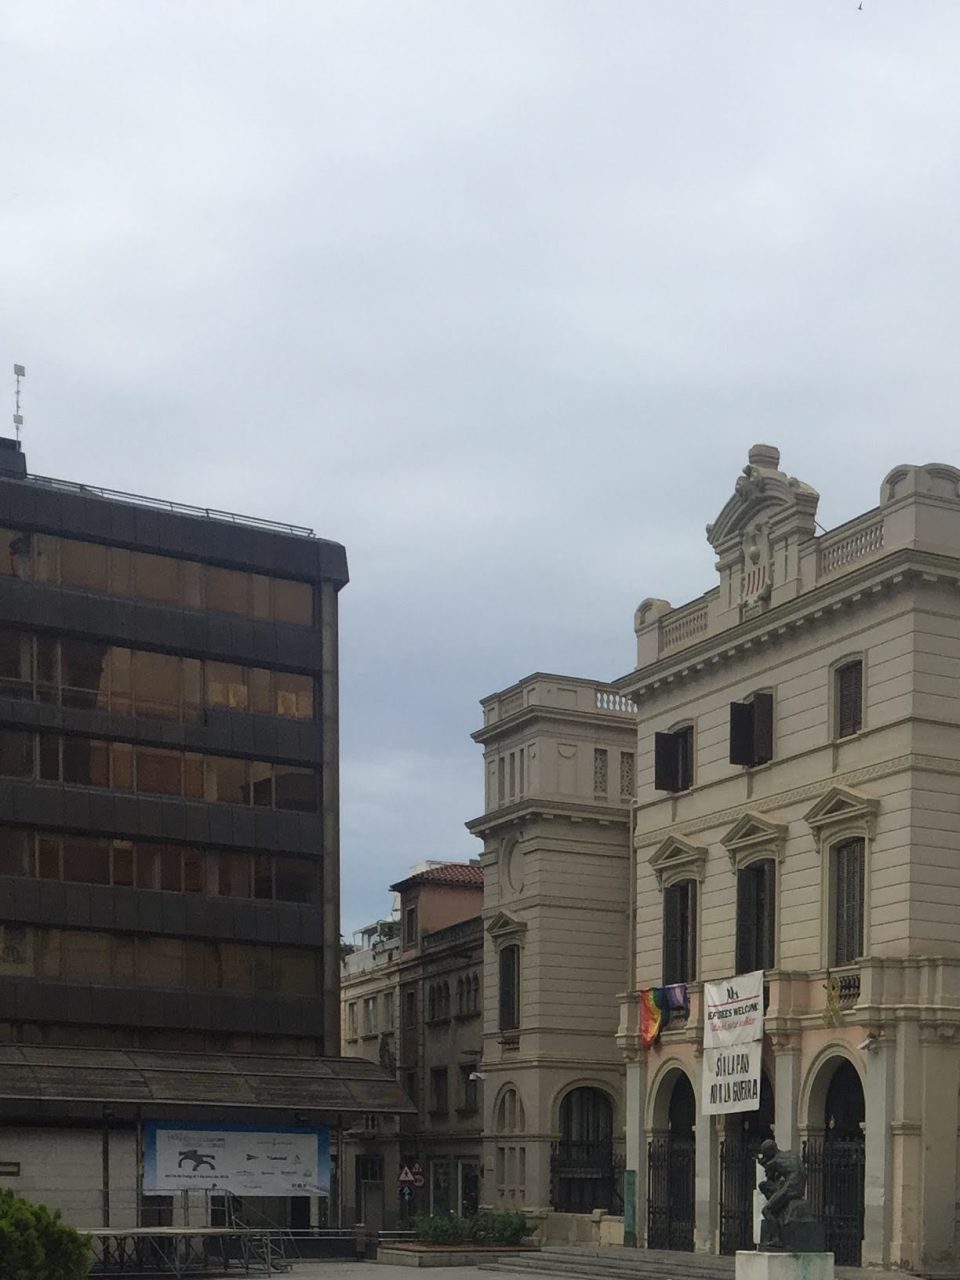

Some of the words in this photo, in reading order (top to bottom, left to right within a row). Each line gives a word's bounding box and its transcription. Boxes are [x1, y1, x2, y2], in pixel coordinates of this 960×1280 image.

[727, 1055, 735, 1075] LA
[736, 1053, 749, 1075] PAU
[710, 1084, 718, 1104] NO
[724, 1082, 731, 1103] LA
[733, 1079, 758, 1102] GUERRA
